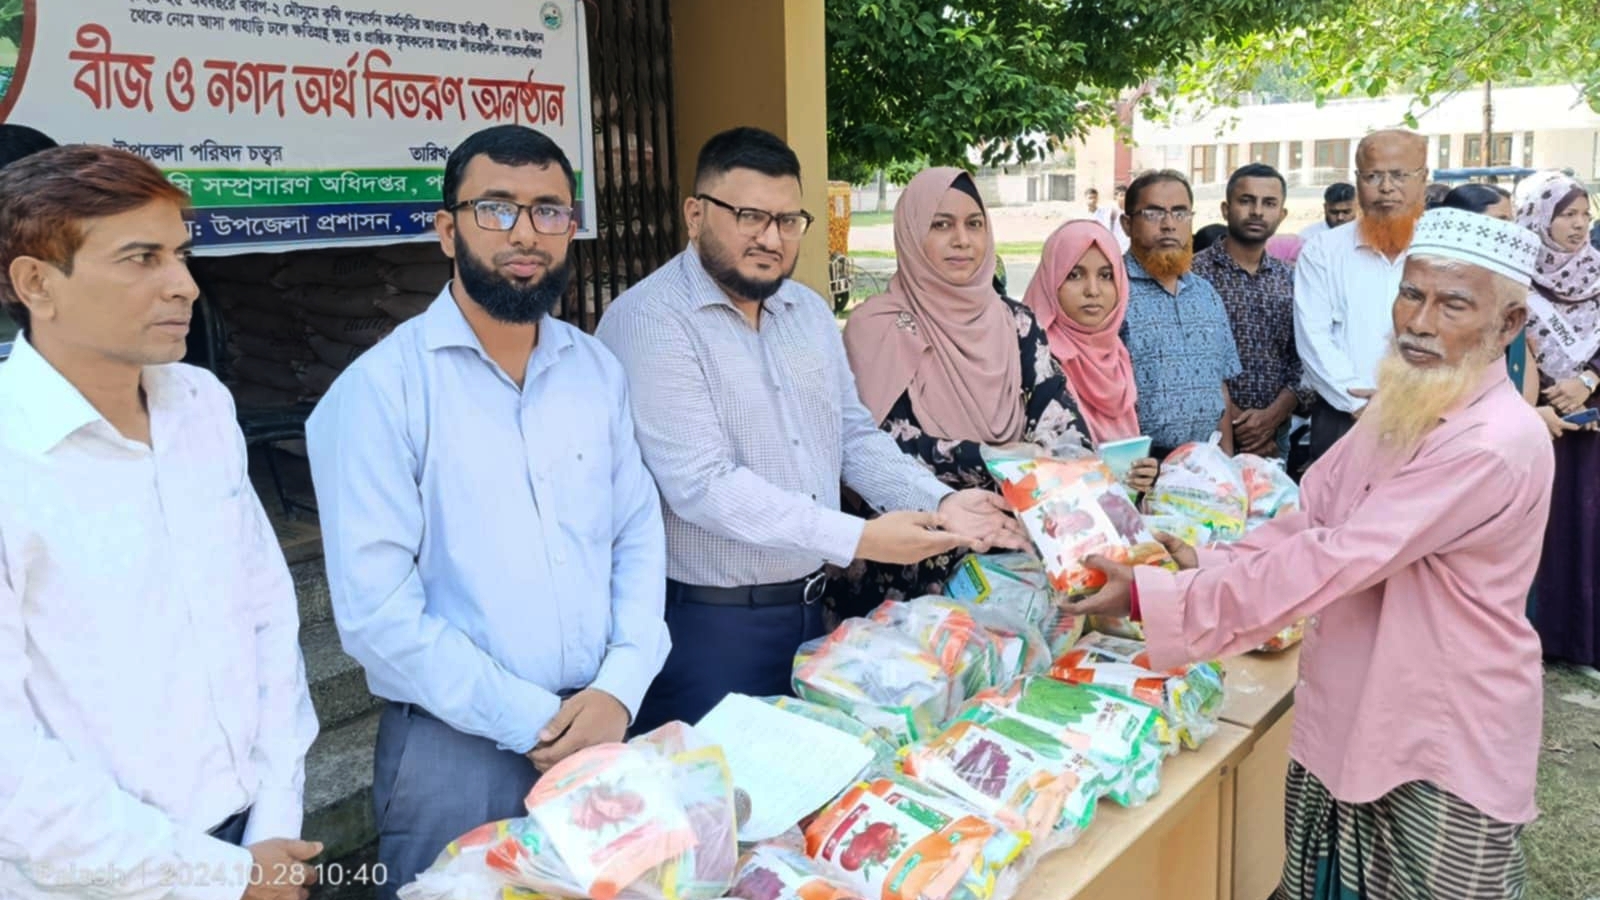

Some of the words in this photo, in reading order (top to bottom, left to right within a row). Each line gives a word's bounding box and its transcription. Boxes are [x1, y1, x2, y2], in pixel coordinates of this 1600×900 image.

[129, 8, 163, 25] থেকে
[167, 11, 195, 28] নেমে
[198, 15, 225, 31] আসা
[268, 22, 288, 37] ঢলে
[353, 31, 362, 43] ও
[322, 5, 341, 26] কৃষি
[69, 23, 156, 113] বীজ
[166, 57, 195, 113] ও
[203, 59, 287, 117] নগদ
[291, 51, 360, 119] অর্থ
[362, 48, 466, 121] বিতরণ
[467, 68, 565, 127] অনষ্ঠান
[190, 139, 242, 163] পরিষদ
[203, 176, 312, 198] সম্প্রসারণ
[210, 213, 310, 236] উপজেলা
